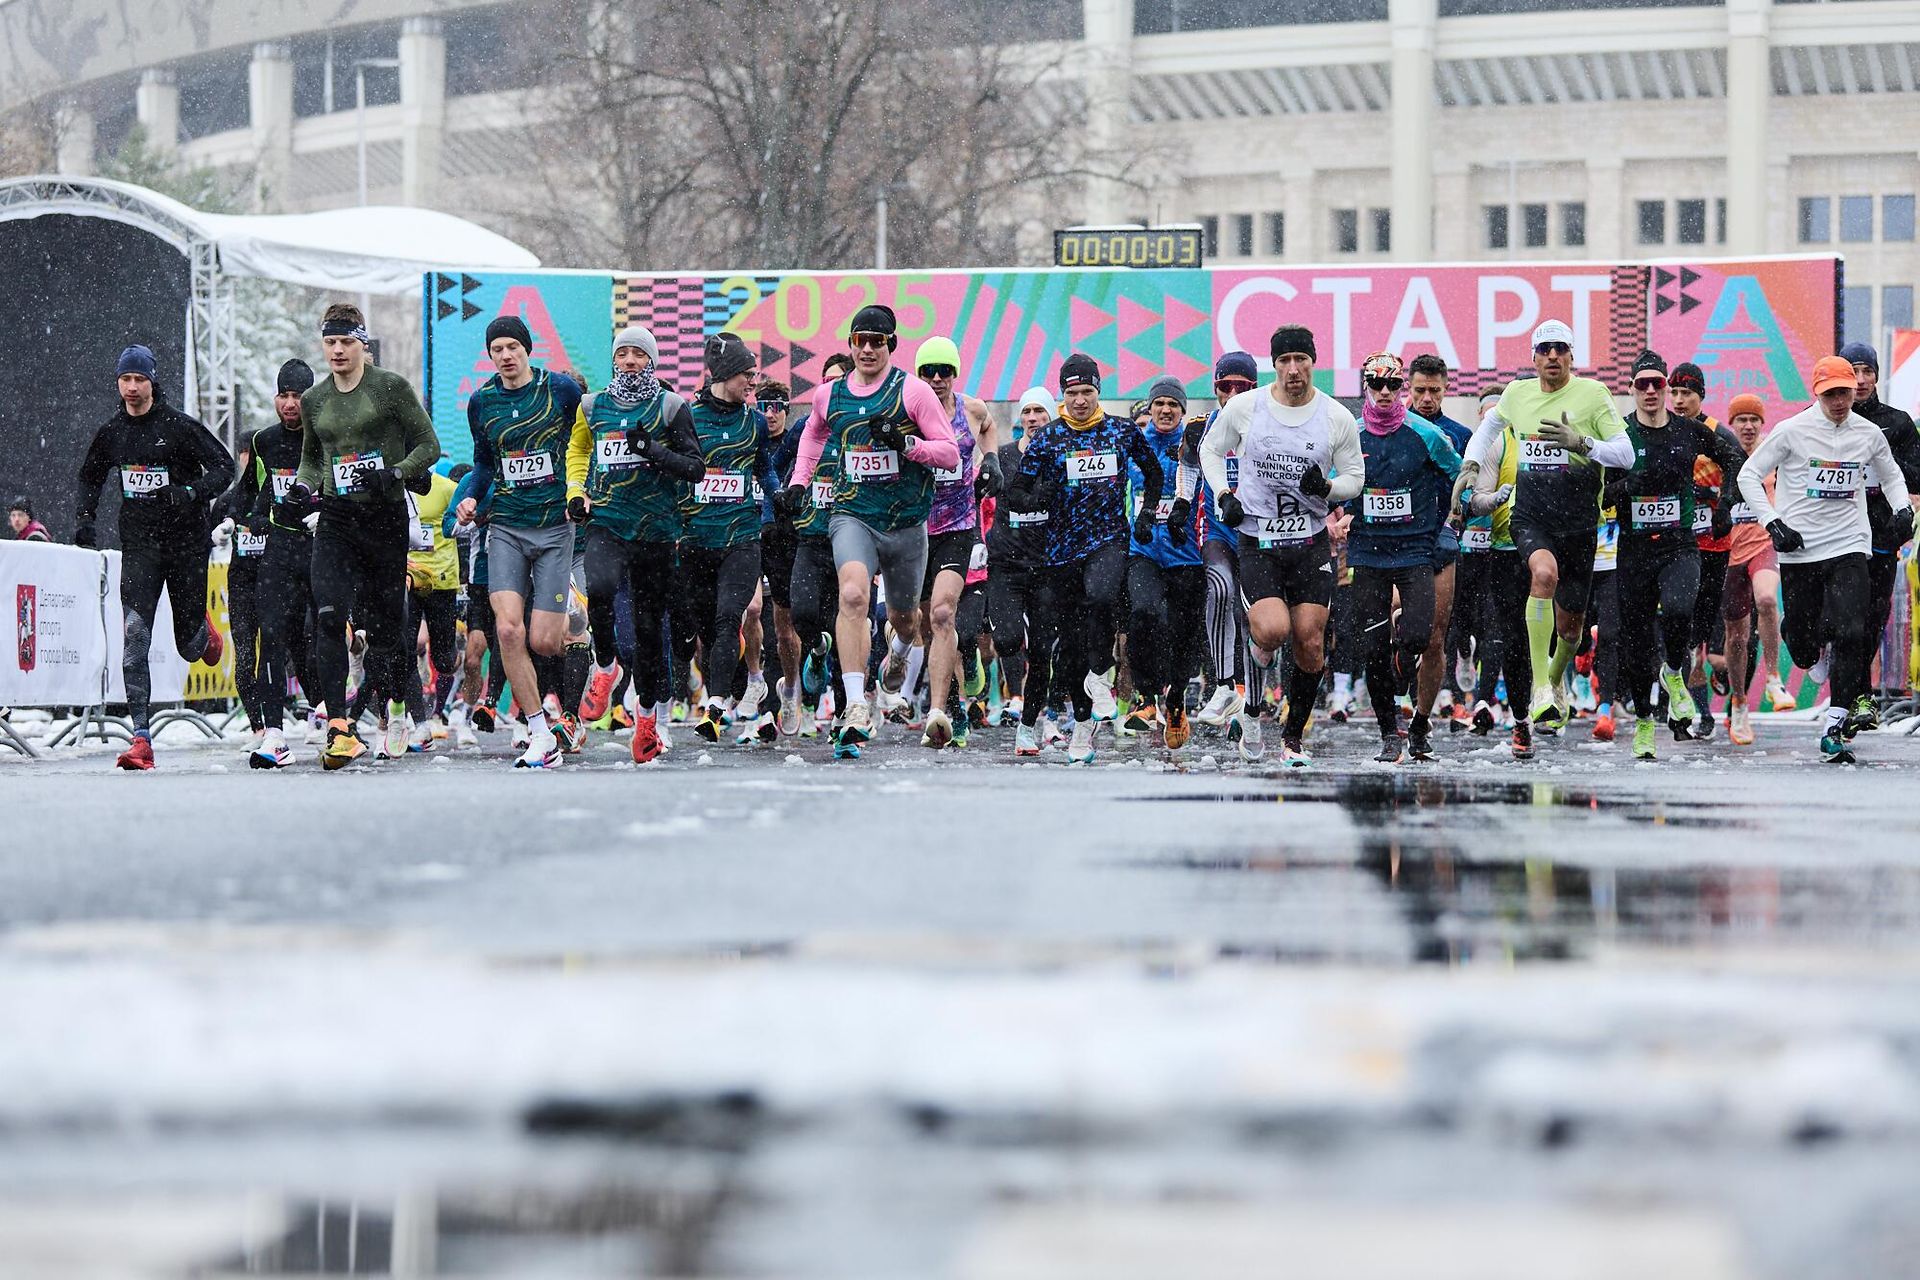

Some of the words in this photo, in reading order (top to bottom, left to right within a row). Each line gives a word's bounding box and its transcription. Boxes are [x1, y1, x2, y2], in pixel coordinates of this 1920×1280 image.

[1062, 236, 1196, 265] 00:00:03
[719, 275, 936, 342] 2025
[1216, 274, 1613, 372] СТАРТ
[604, 441, 633, 457] 672
[508, 456, 545, 474] 6729
[851, 454, 890, 471] 7351
[1078, 457, 1106, 473] 246
[1252, 460, 1293, 472] TRAINING
[1265, 453, 1310, 465] ALTITUDE
[128, 472, 163, 487] 4793
[1815, 469, 1853, 485] 4781
[702, 478, 739, 493] 7279
[1369, 496, 1405, 510] 1358
[1638, 503, 1674, 517] 6952
[1265, 517, 1306, 534] 4222
